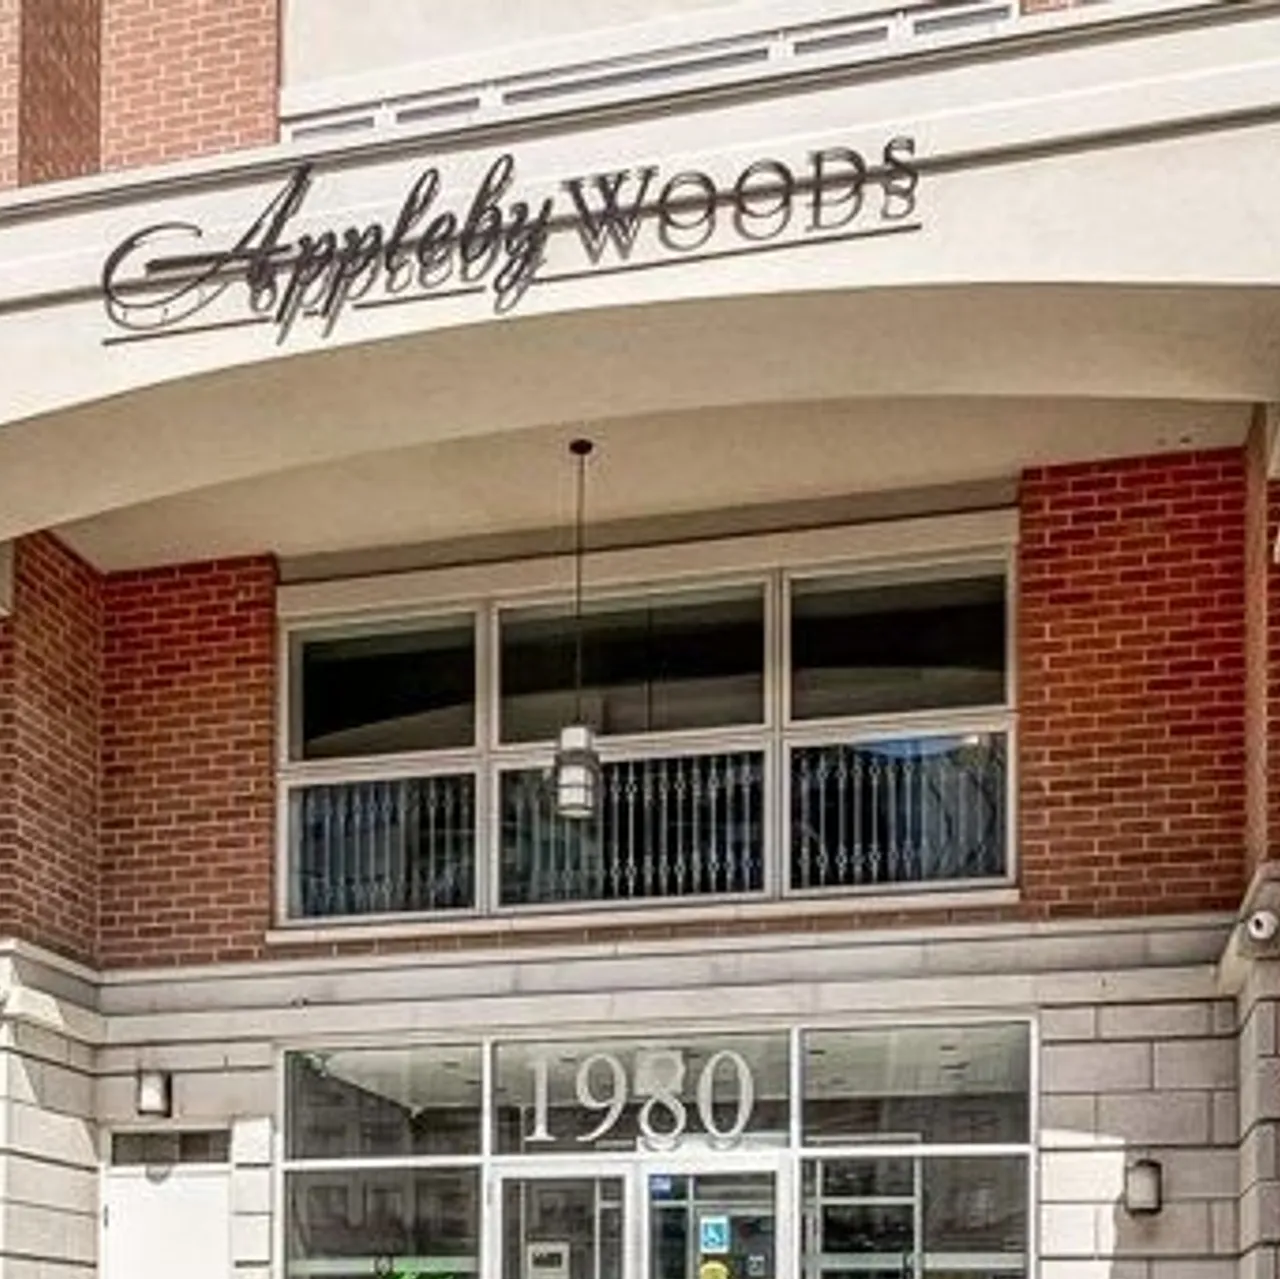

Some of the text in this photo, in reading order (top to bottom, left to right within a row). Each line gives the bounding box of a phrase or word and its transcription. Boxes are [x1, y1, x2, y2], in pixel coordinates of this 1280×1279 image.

[103, 136, 919, 342] Appleby WOODS
[523, 1050, 754, 1142] 1980
